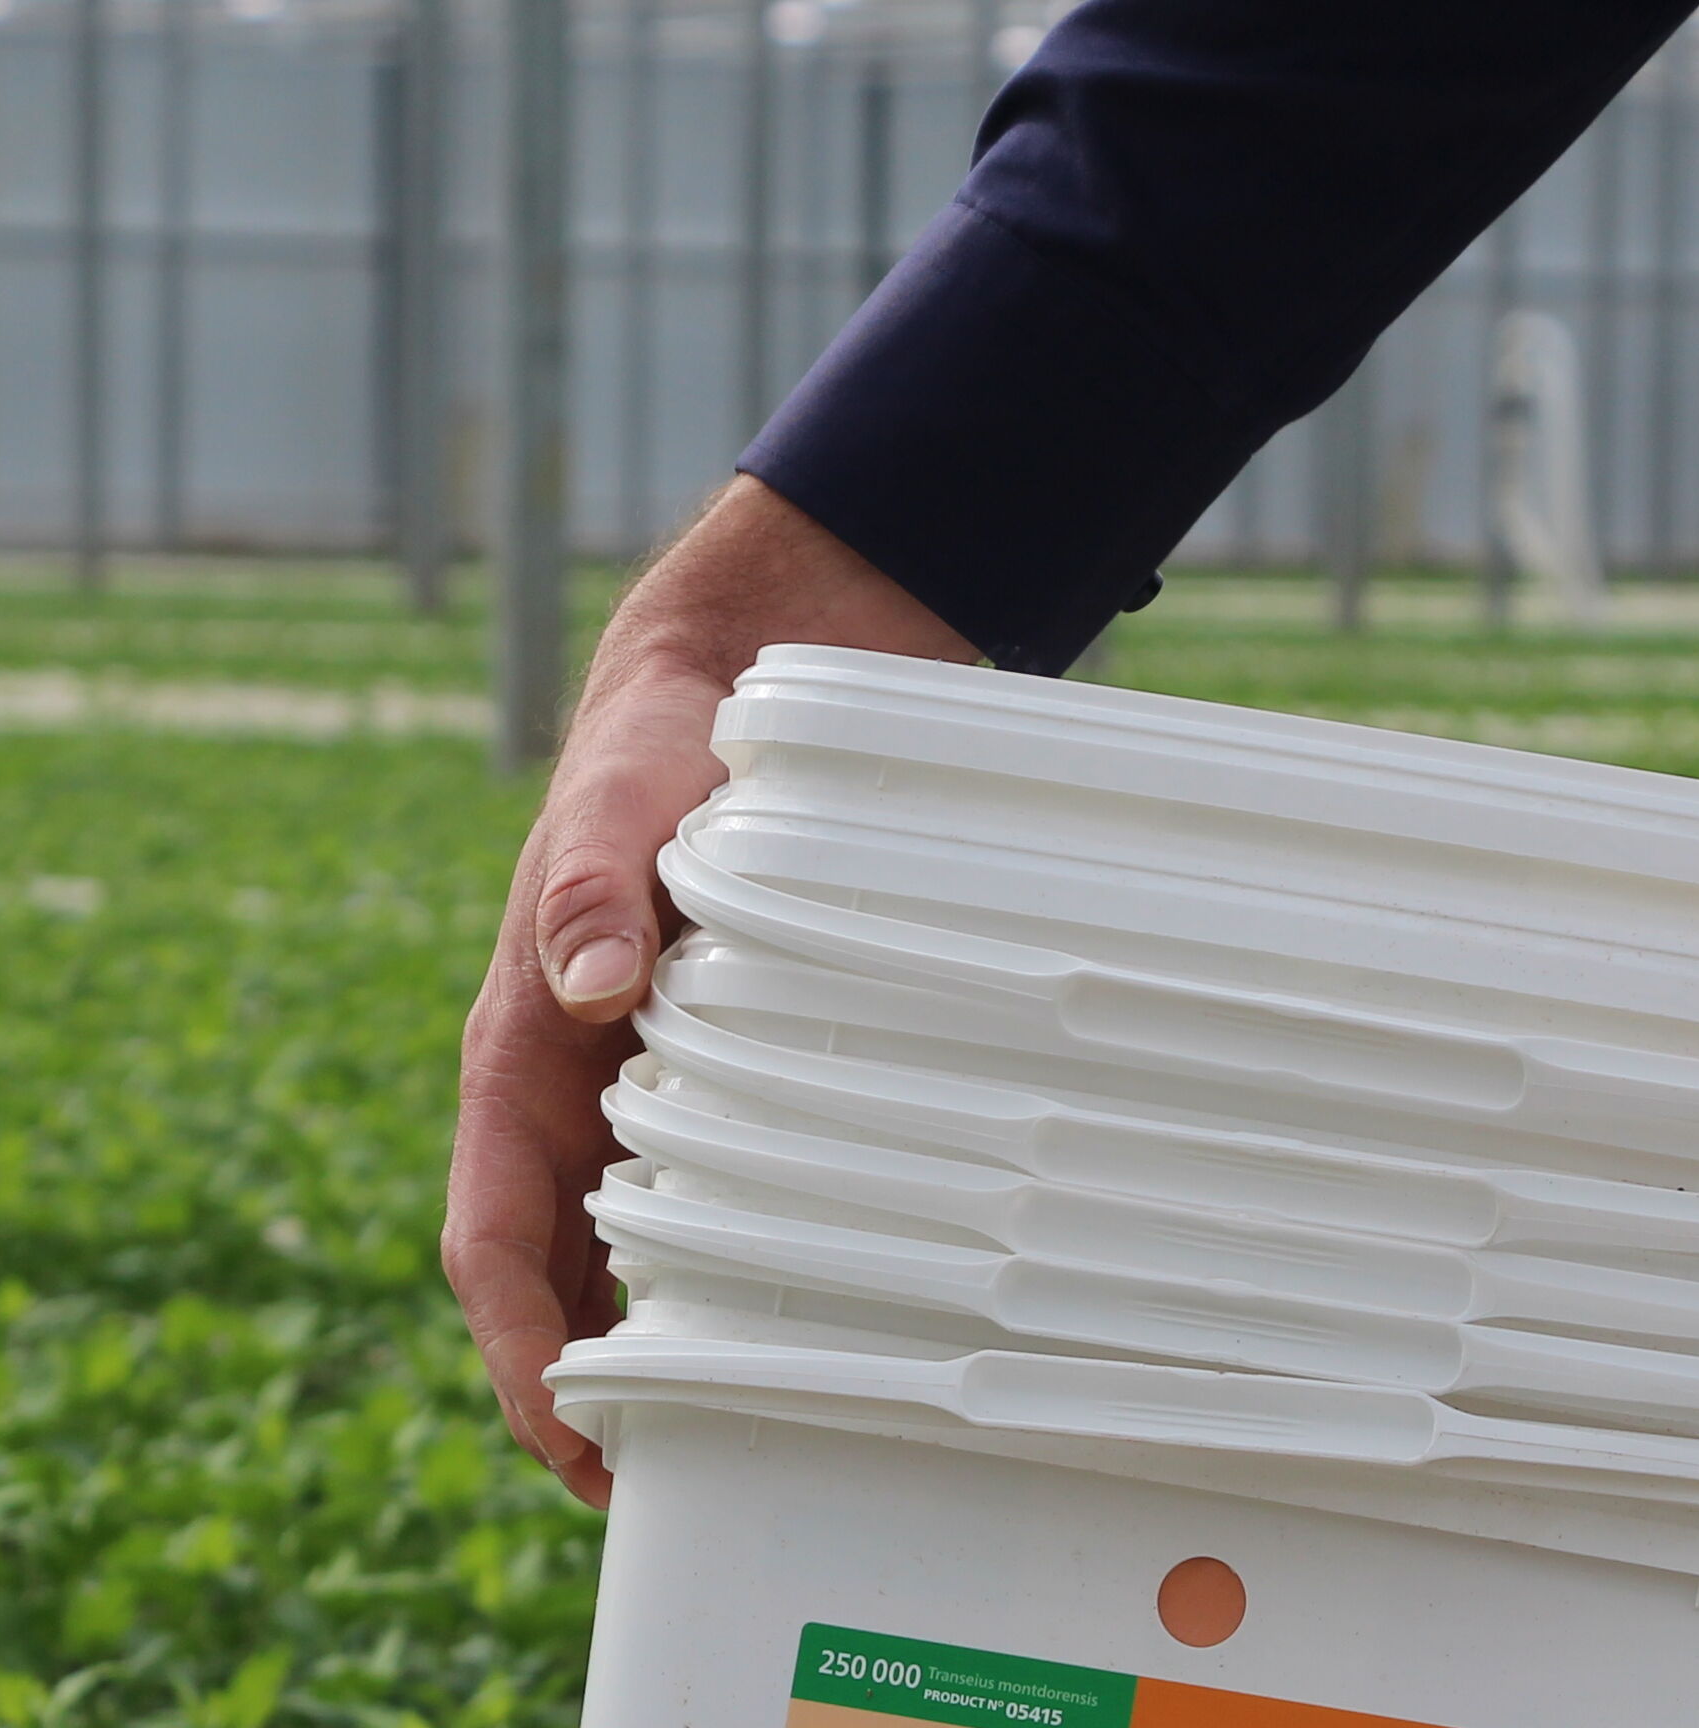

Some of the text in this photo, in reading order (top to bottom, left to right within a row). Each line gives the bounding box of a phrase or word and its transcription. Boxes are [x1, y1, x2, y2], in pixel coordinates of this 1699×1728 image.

[818, 1649, 922, 1689] 250 000
[927, 1666, 1098, 1708] Transeius montdorensis
[923, 1688, 987, 1709] PRODUCT
[1005, 1701, 1063, 1727] 05415
